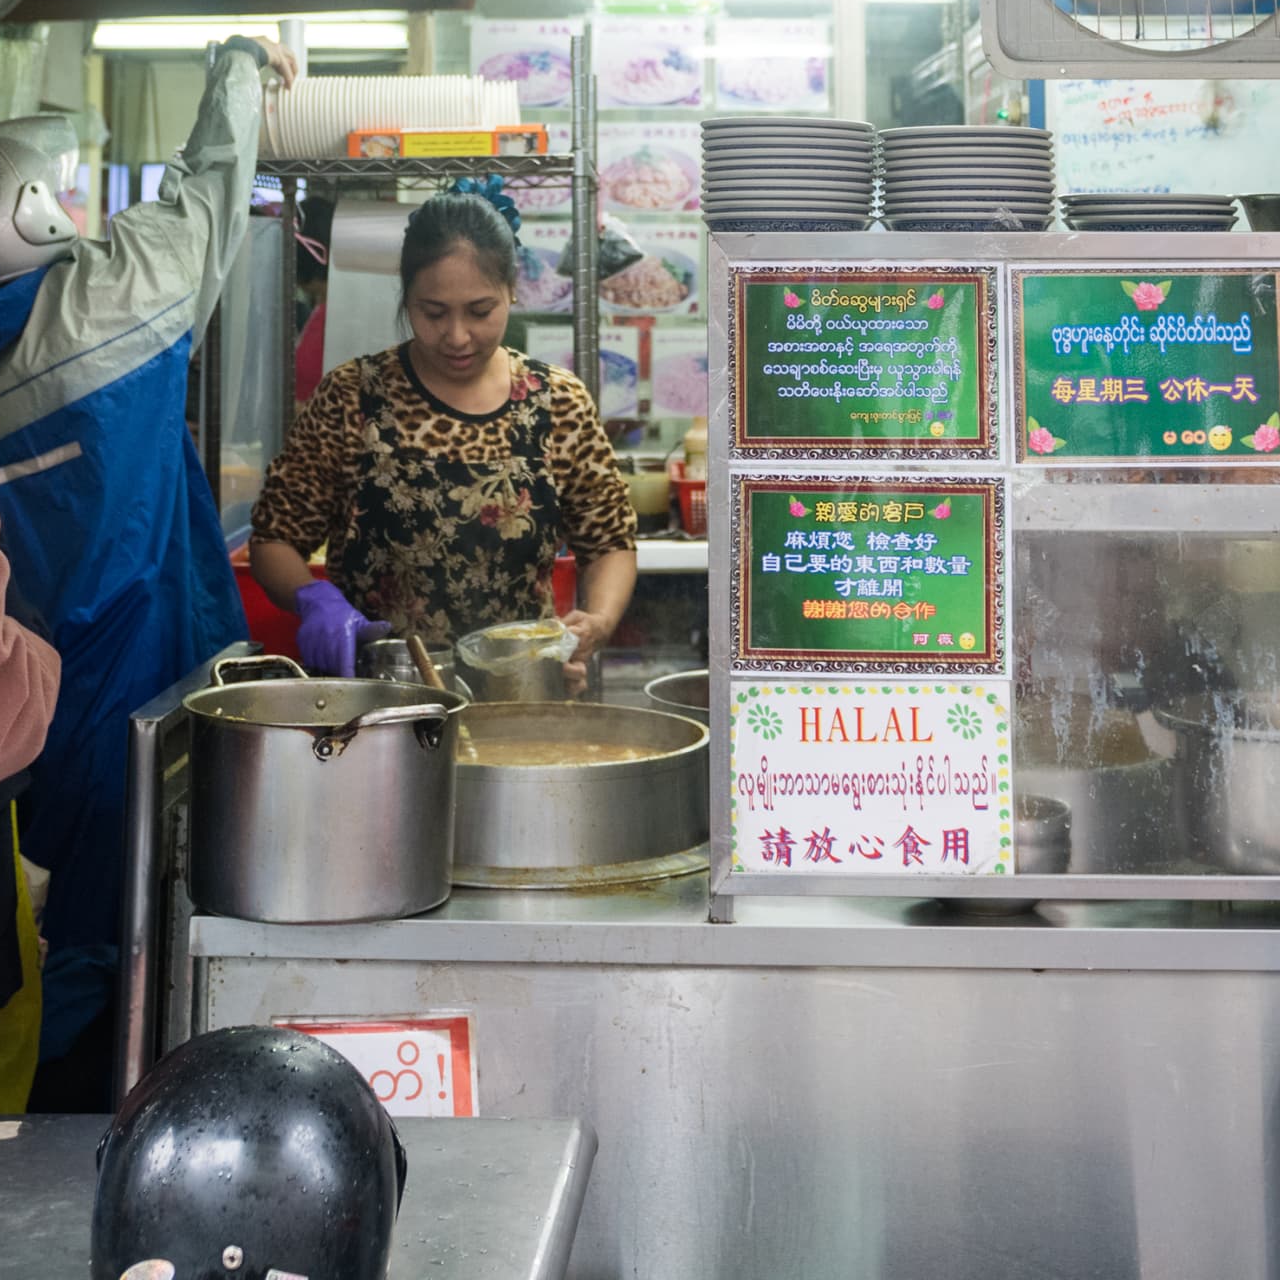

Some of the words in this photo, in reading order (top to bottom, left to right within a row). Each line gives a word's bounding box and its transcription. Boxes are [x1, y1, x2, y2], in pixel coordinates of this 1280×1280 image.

[1051, 377, 1150, 404] 每星期三
[1159, 376, 1258, 403] 公休一天
[815, 501, 925, 523] 親愛的客戶
[783, 531, 856, 550] 麻煩您
[866, 531, 938, 552] 檢查好
[761, 552, 972, 575] 自己要的東西和數量
[834, 577, 904, 597] 才離開
[802, 599, 937, 621] 謝謝您的合作
[799, 706, 934, 743] HALAL
[757, 824, 971, 868] 請放心食用
